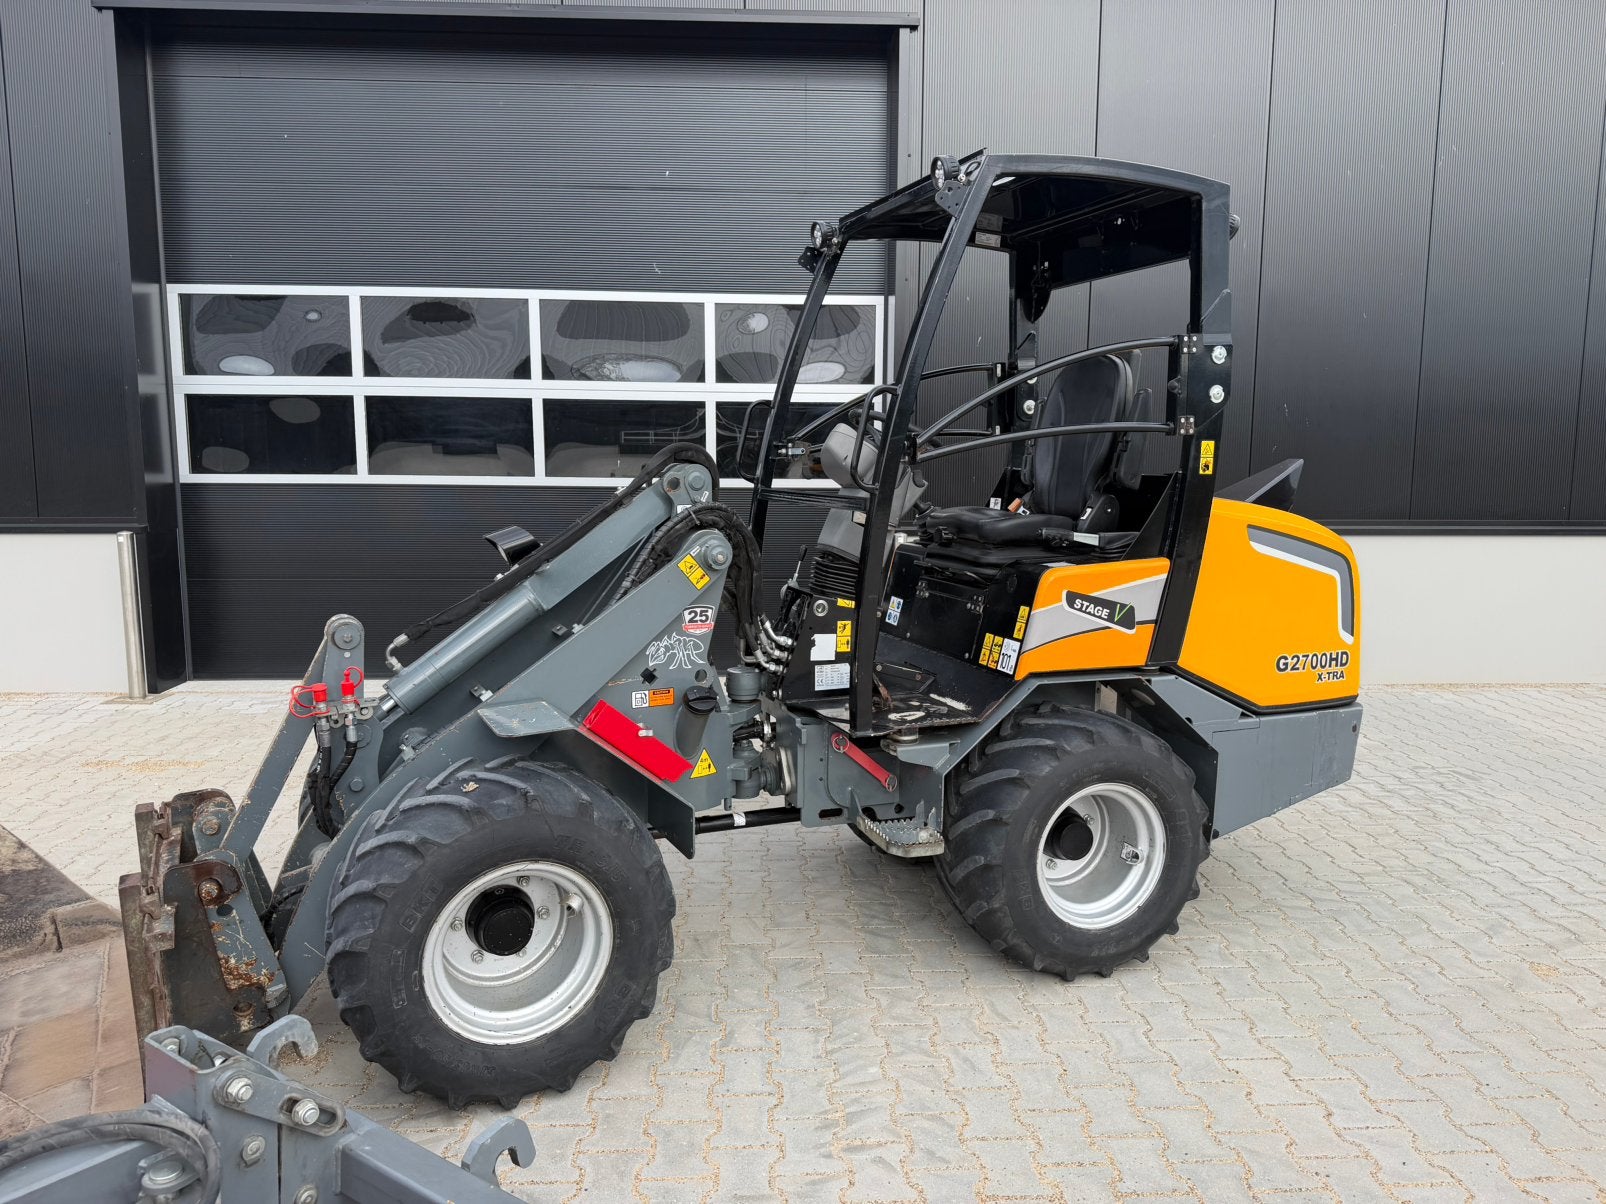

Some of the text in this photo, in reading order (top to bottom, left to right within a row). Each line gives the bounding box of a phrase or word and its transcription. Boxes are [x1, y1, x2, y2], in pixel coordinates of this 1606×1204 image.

[687, 609, 709, 624] 25
[1074, 598, 1133, 622] STAGE V
[1000, 652, 1012, 671] 101
[1275, 650, 1350, 672] G2700HD
[1316, 671, 1345, 682] X-TRA
